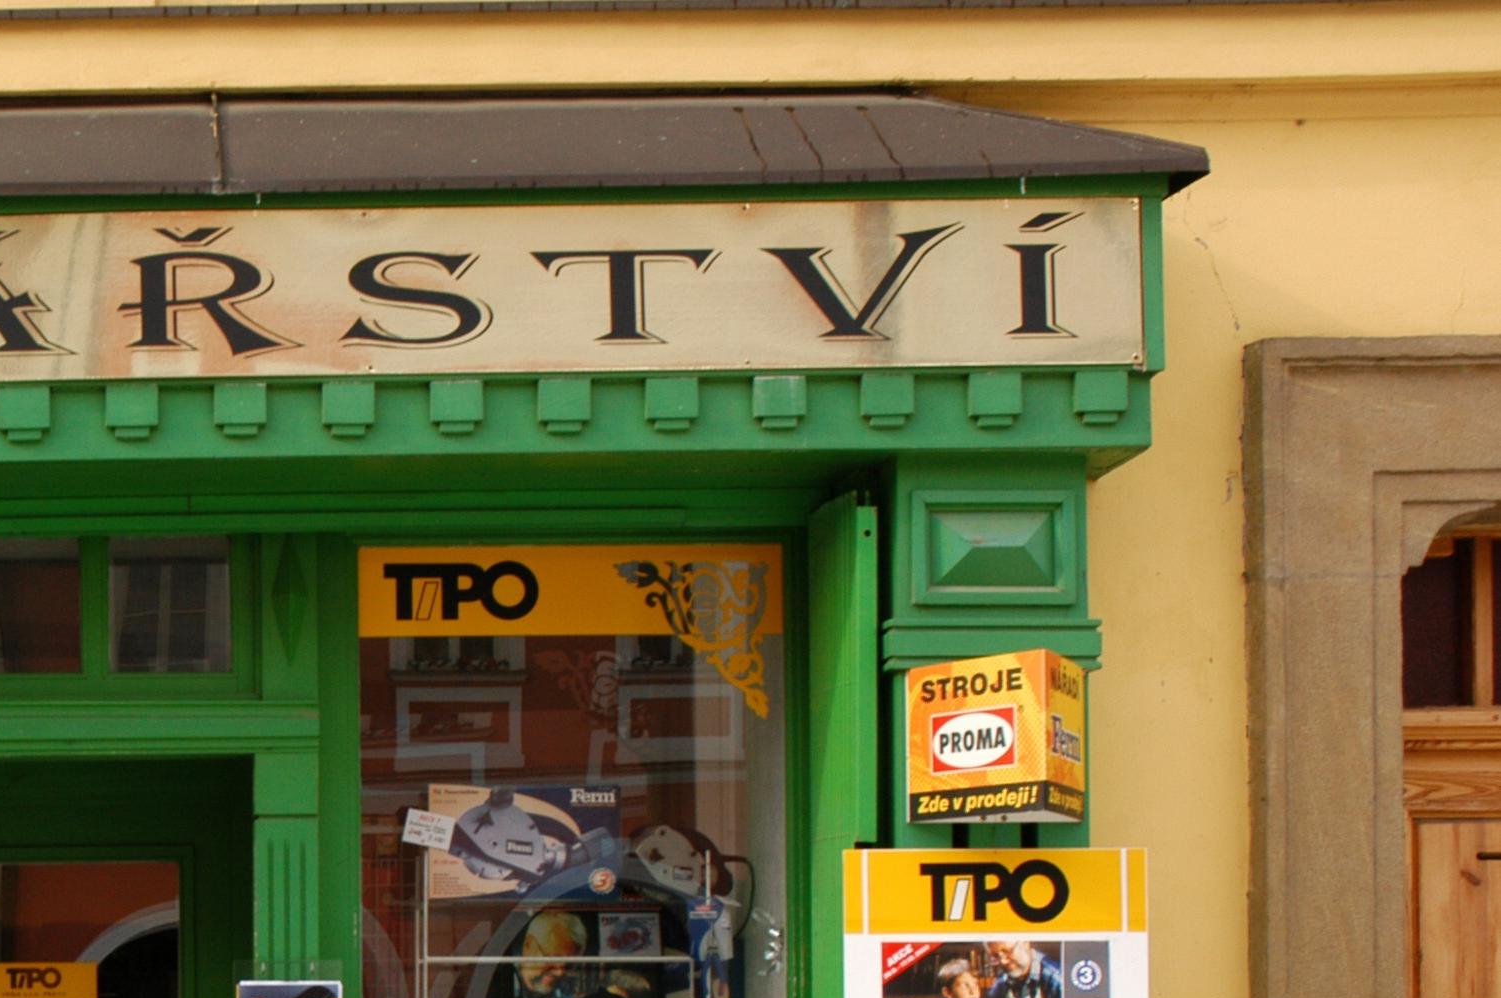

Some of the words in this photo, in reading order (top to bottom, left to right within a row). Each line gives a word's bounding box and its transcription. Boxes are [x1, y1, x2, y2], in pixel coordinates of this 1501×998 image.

[383, 560, 539, 621] TIPO
[921, 667, 1023, 703] STROJE
[938, 726, 1006, 755] PROMA
[570, 788, 616, 804] Ferm
[917, 793, 949, 814] Zde
[953, 797, 961, 811] v
[965, 786, 1038, 814] prodeji!
[920, 859, 1070, 923] TIPO
[6, 967, 62, 990] TIPO
[1079, 966, 1094, 984] 3
